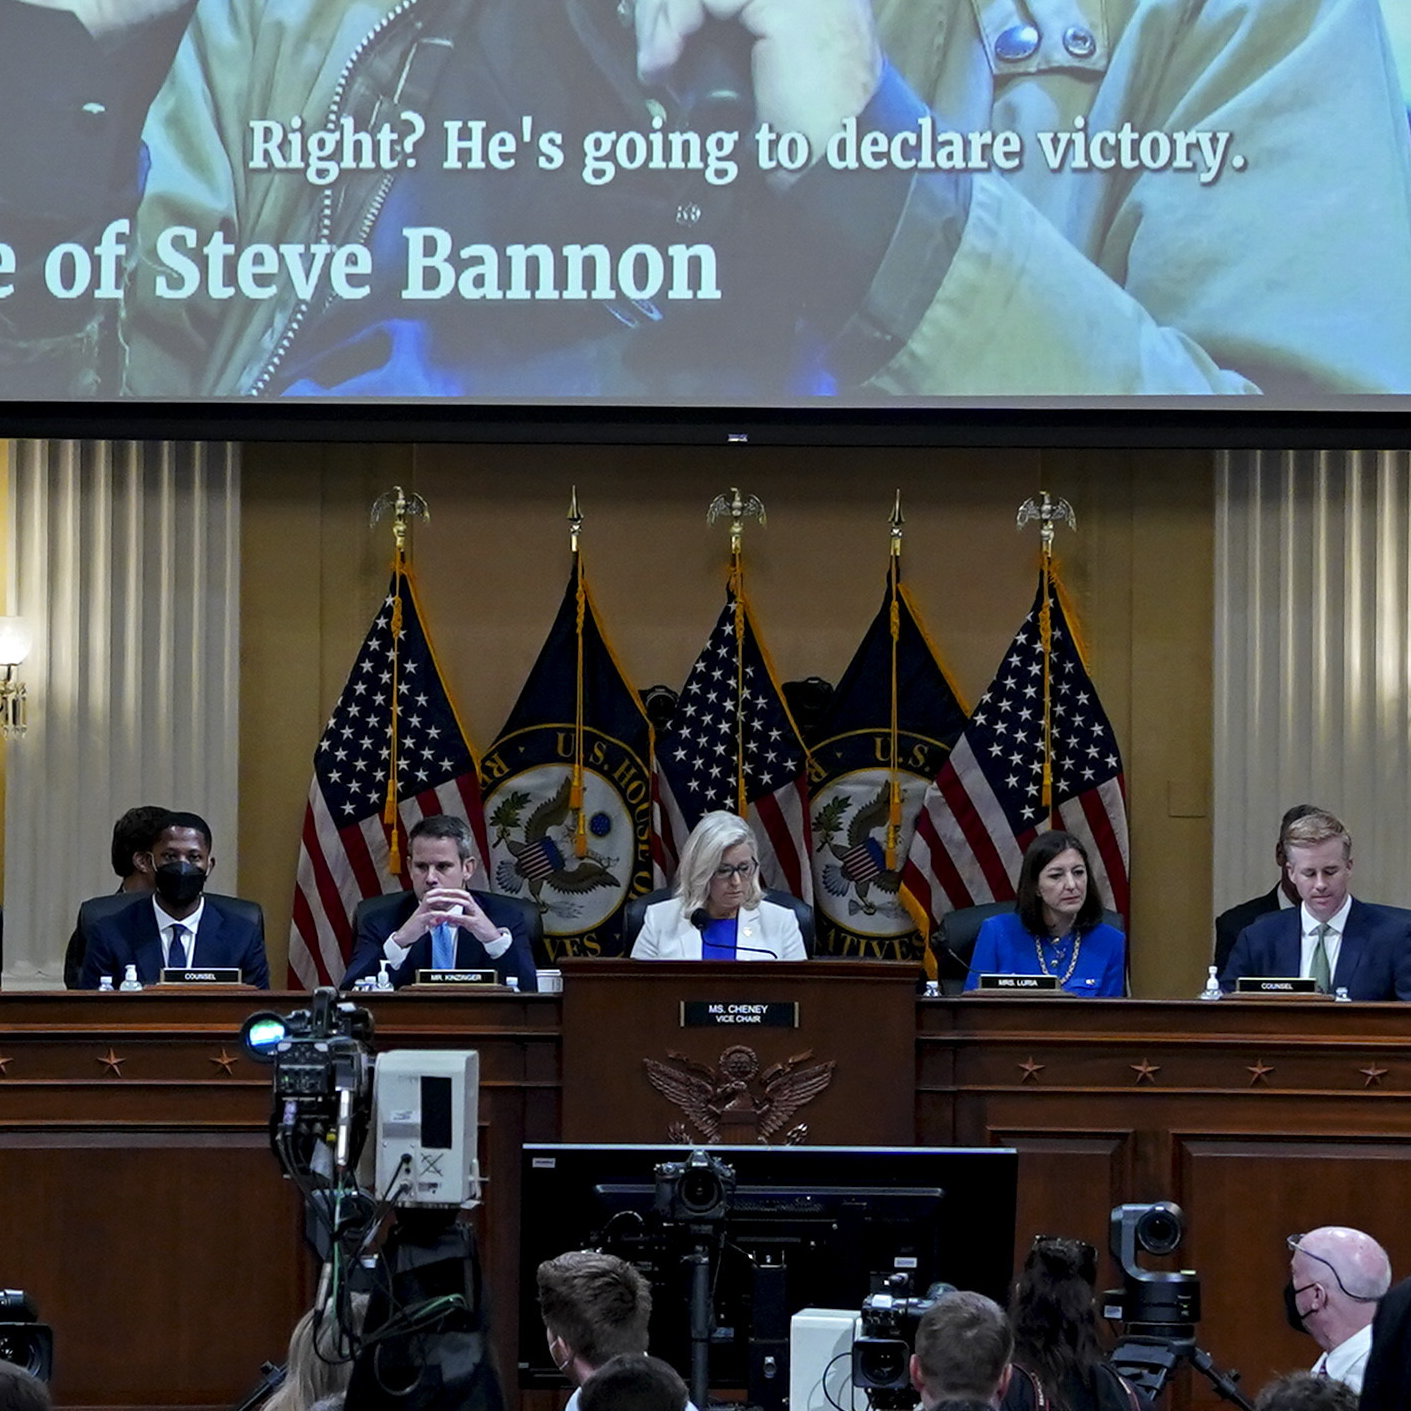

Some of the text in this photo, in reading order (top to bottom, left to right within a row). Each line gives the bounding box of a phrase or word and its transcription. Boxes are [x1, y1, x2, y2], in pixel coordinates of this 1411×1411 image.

[248, 116, 1248, 186] Right? He's going to declare victory.
[43, 219, 130, 299] of
[154, 226, 372, 299] Steve
[400, 226, 722, 300] Bannon
[708, 1004, 768, 1014] MS. CHENEY
[715, 1015, 761, 1023] VICE CHAIR
